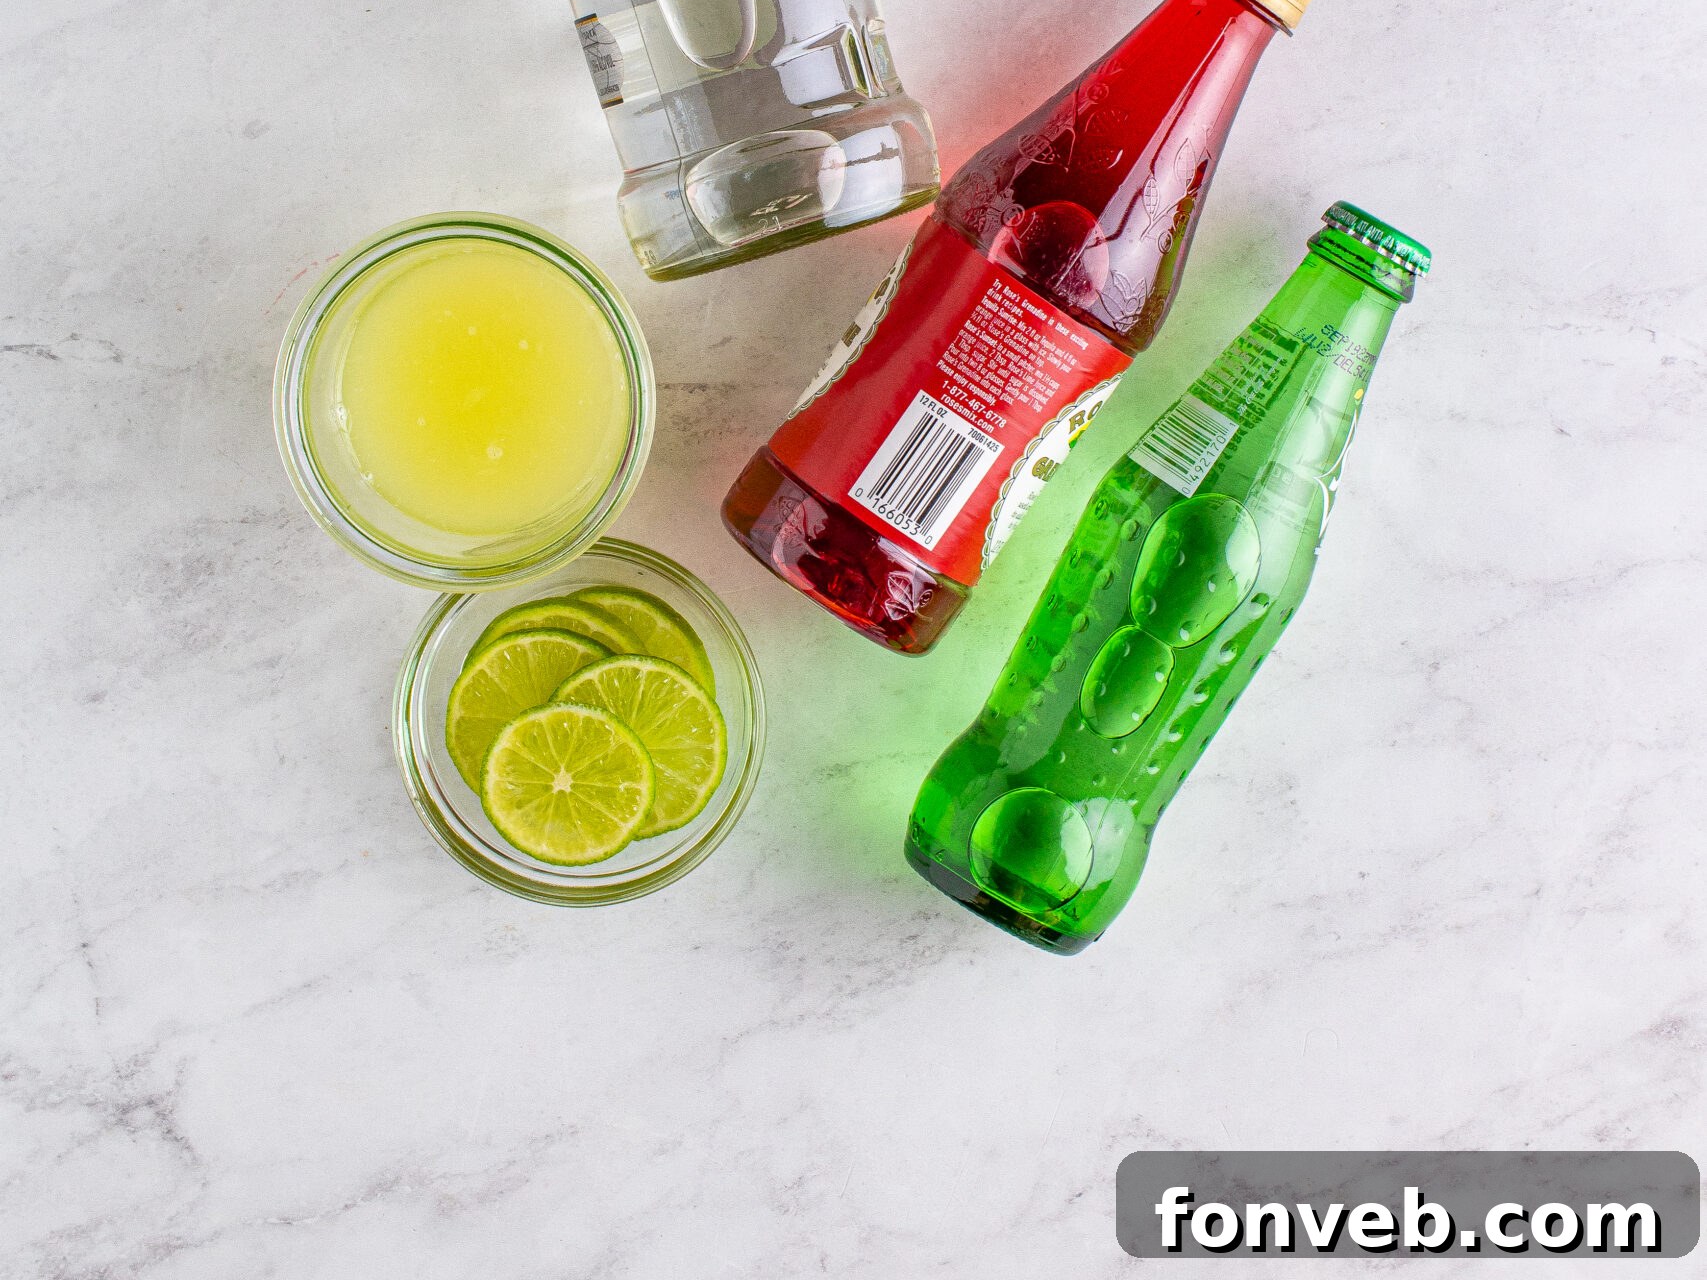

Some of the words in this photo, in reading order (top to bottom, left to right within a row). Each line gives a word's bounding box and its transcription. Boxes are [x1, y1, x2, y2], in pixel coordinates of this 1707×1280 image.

[1356, 220, 1385, 242] ATLANTA,
[1383, 235, 1395, 250] GA
[986, 287, 1002, 302] drink
[1001, 298, 1023, 317] recipes.
[1002, 285, 1020, 302] Rose's
[1021, 299, 1047, 320] Grenadine
[963, 319, 981, 335] Rose's
[979, 330, 997, 348] Sunset:
[1005, 350, 1021, 362] small
[973, 304, 993, 320] orange
[990, 316, 1005, 328] juice
[1012, 332, 1028, 346] glass
[1027, 340, 1039, 352] with
[1059, 363, 1071, 373] pour
[981, 295, 999, 312] Tequila
[1016, 320, 1027, 331] Mix
[1037, 335, 1056, 354] Tequila
[988, 323, 1004, 339] Rose's
[1003, 334, 1029, 356] Grenadine
[936, 359, 954, 376] Please
[952, 372, 968, 386] enjoy
[966, 382, 996, 405] responsibly.
[942, 350, 958, 366] Rose's
[956, 361, 981, 382] Grenadine
[979, 377, 990, 388] into
[988, 384, 1002, 396] each
[946, 343, 960, 355] Pour
[958, 351, 969, 362] into
[967, 358, 978, 368] two
[1017, 393, 1029, 403] pour
[956, 329, 976, 345] orange
[973, 340, 989, 355] juice,
[1007, 361, 1023, 377] Rose's
[1022, 371, 1035, 384] Lime
[1033, 379, 1046, 392] juice
[987, 359, 998, 370] Stir
[996, 367, 1010, 378] until
[1008, 375, 1023, 390] sugar
[919, 394, 930, 405] 12
[928, 400, 937, 412] FL
[937, 406, 948, 419] OZ
[940, 393, 995, 434] rosesmix.com
[941, 380, 1008, 428] 1-877-467-6778
[968, 427, 999, 453] 70061425
[1181, 486, 1191, 495] 0
[1190, 434, 1227, 483] 492170
[854, 487, 864, 498] 0
[870, 497, 919, 536] 166053
[924, 535, 933, 545] 0
